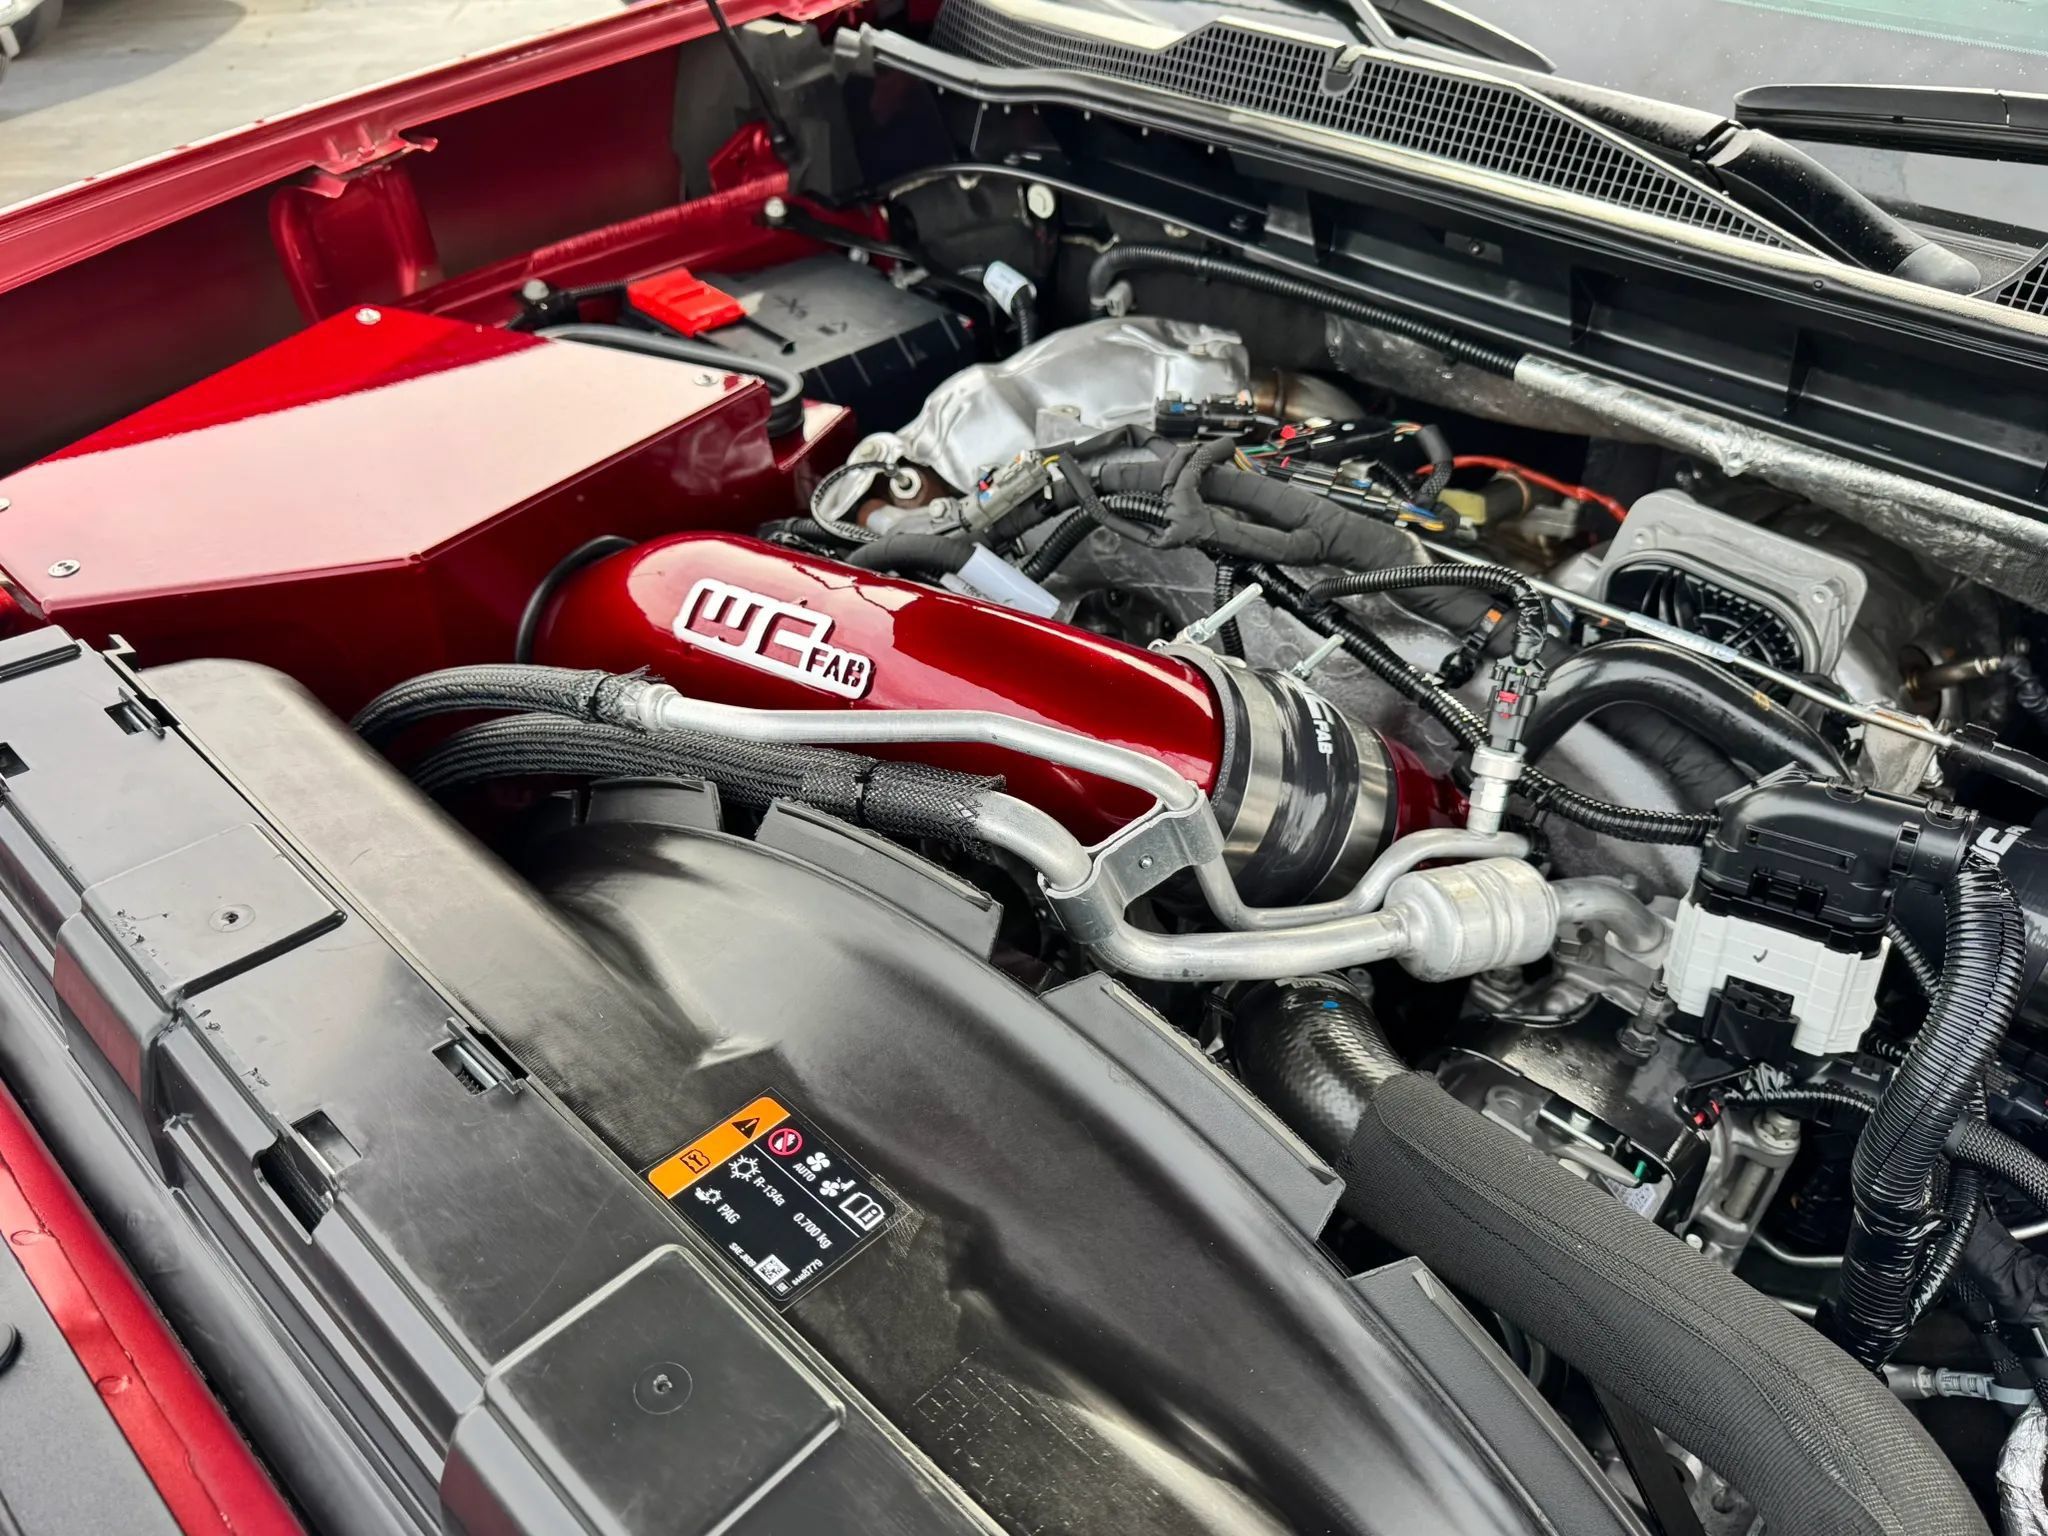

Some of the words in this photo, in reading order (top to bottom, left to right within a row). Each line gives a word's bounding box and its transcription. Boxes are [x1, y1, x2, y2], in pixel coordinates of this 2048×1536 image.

[806, 647, 864, 688] FAB
[1313, 719, 1334, 755] FAB
[793, 1162, 817, 1182] AUTO
[753, 1176, 786, 1207] R-134a
[716, 1203, 742, 1225] PAG
[792, 1212, 822, 1238] 0.700
[816, 1231, 833, 1249] kg
[728, 1242, 745, 1257] SAE
